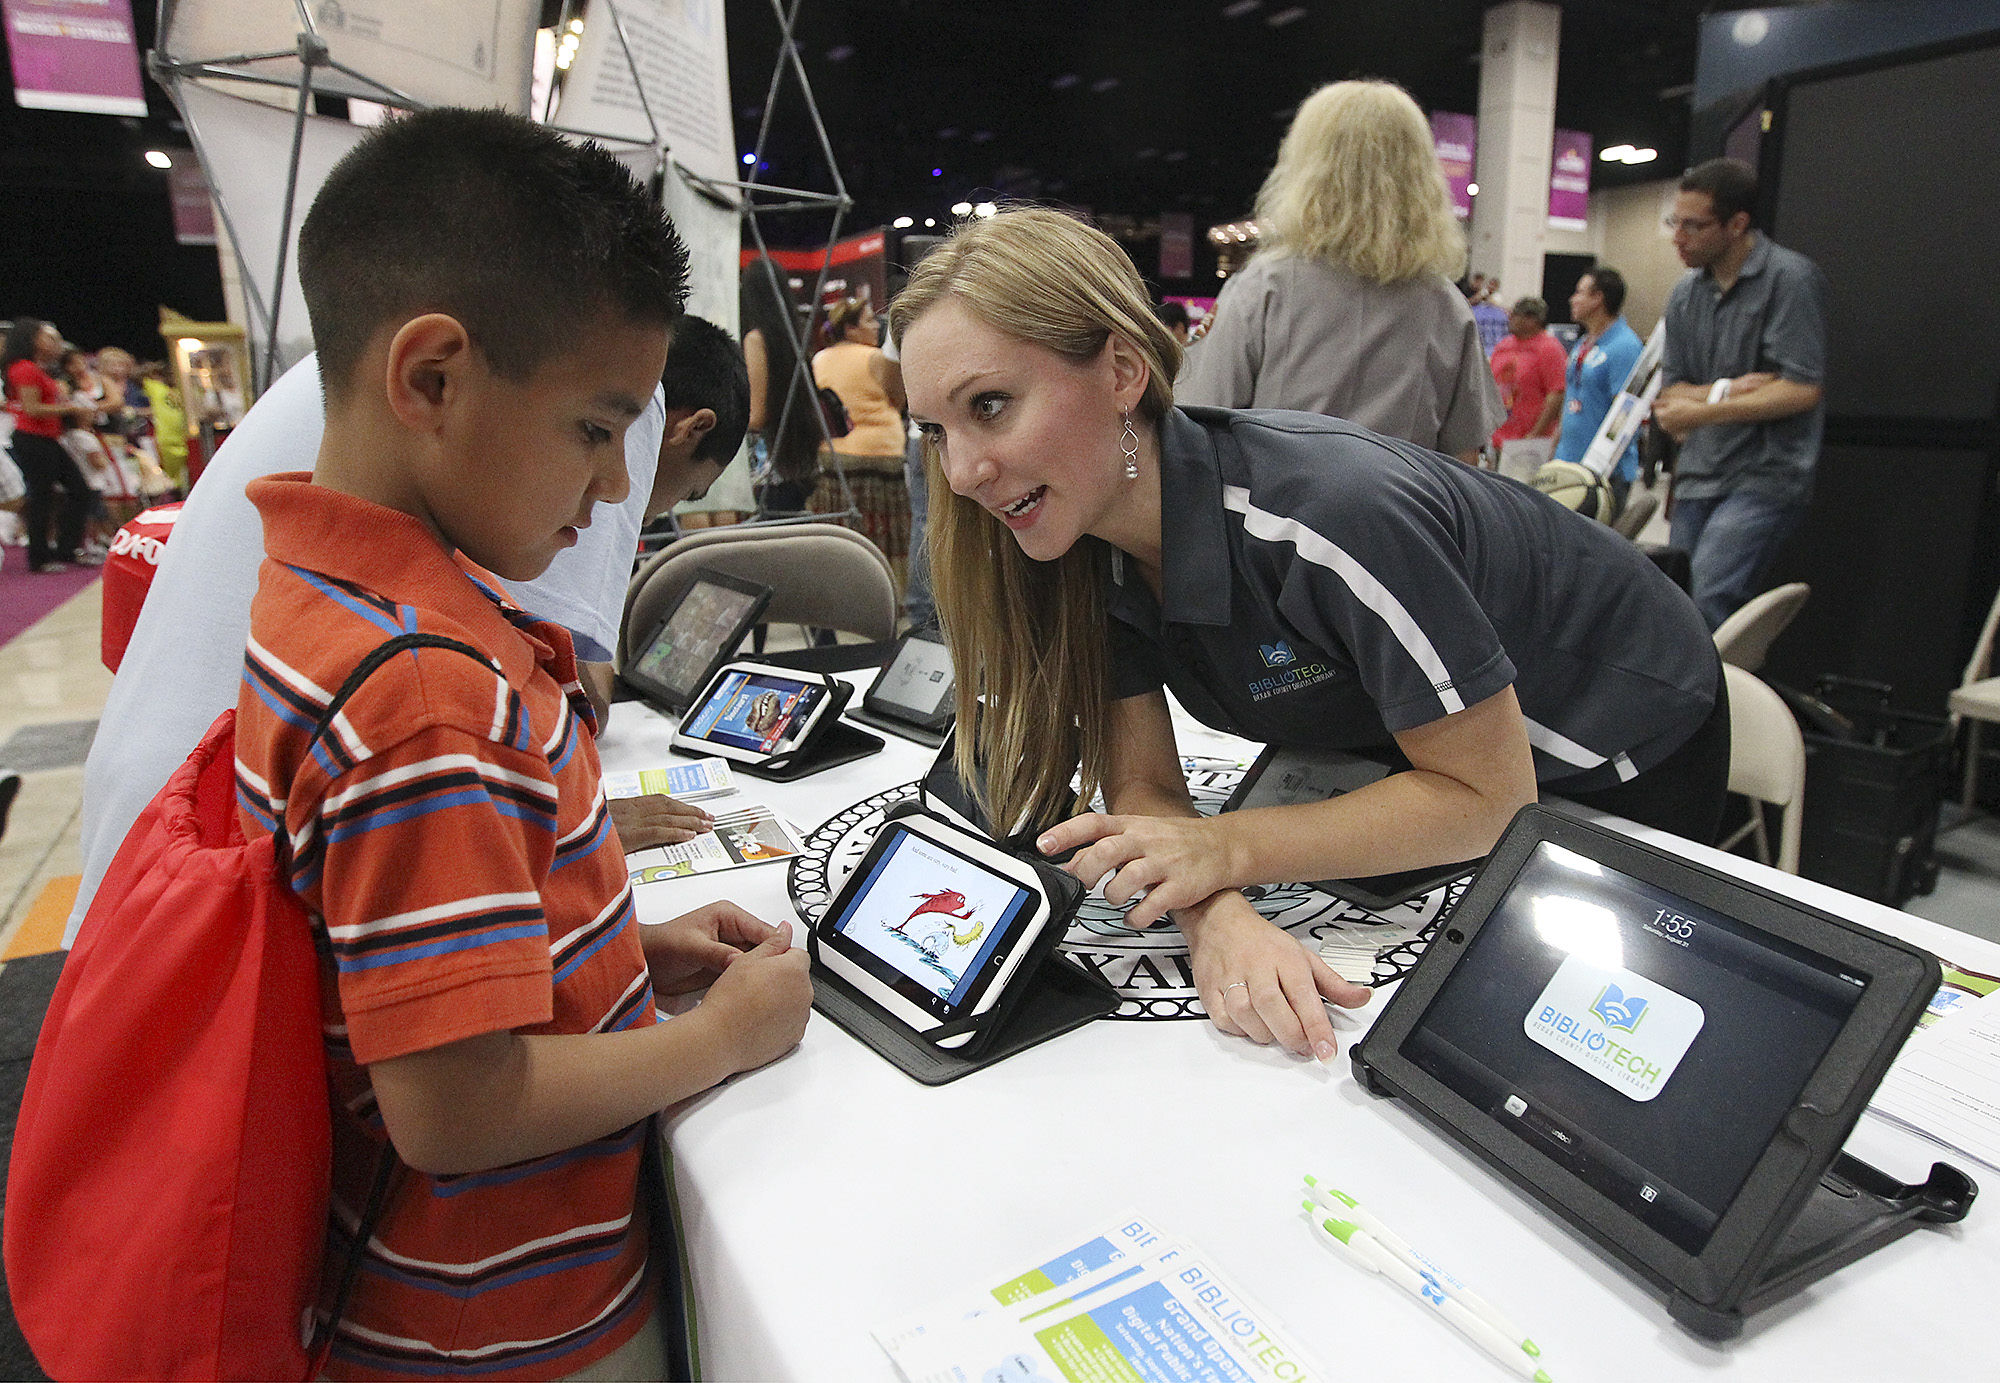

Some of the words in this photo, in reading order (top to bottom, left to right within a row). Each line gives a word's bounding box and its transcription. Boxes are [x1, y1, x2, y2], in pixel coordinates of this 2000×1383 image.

[1653, 909, 1697, 938] 1:55
[1538, 1005, 1662, 1085] BIBLIOTECH
[1584, 1051, 1615, 1073] DIGITAL
[1617, 1070, 1650, 1092] LIBRARY
[1121, 1304, 1163, 1345] Digital
[1154, 1342, 1192, 1382] Public
[1156, 1318, 1205, 1370] Nation's
[1163, 1299, 1209, 1342] Grand
